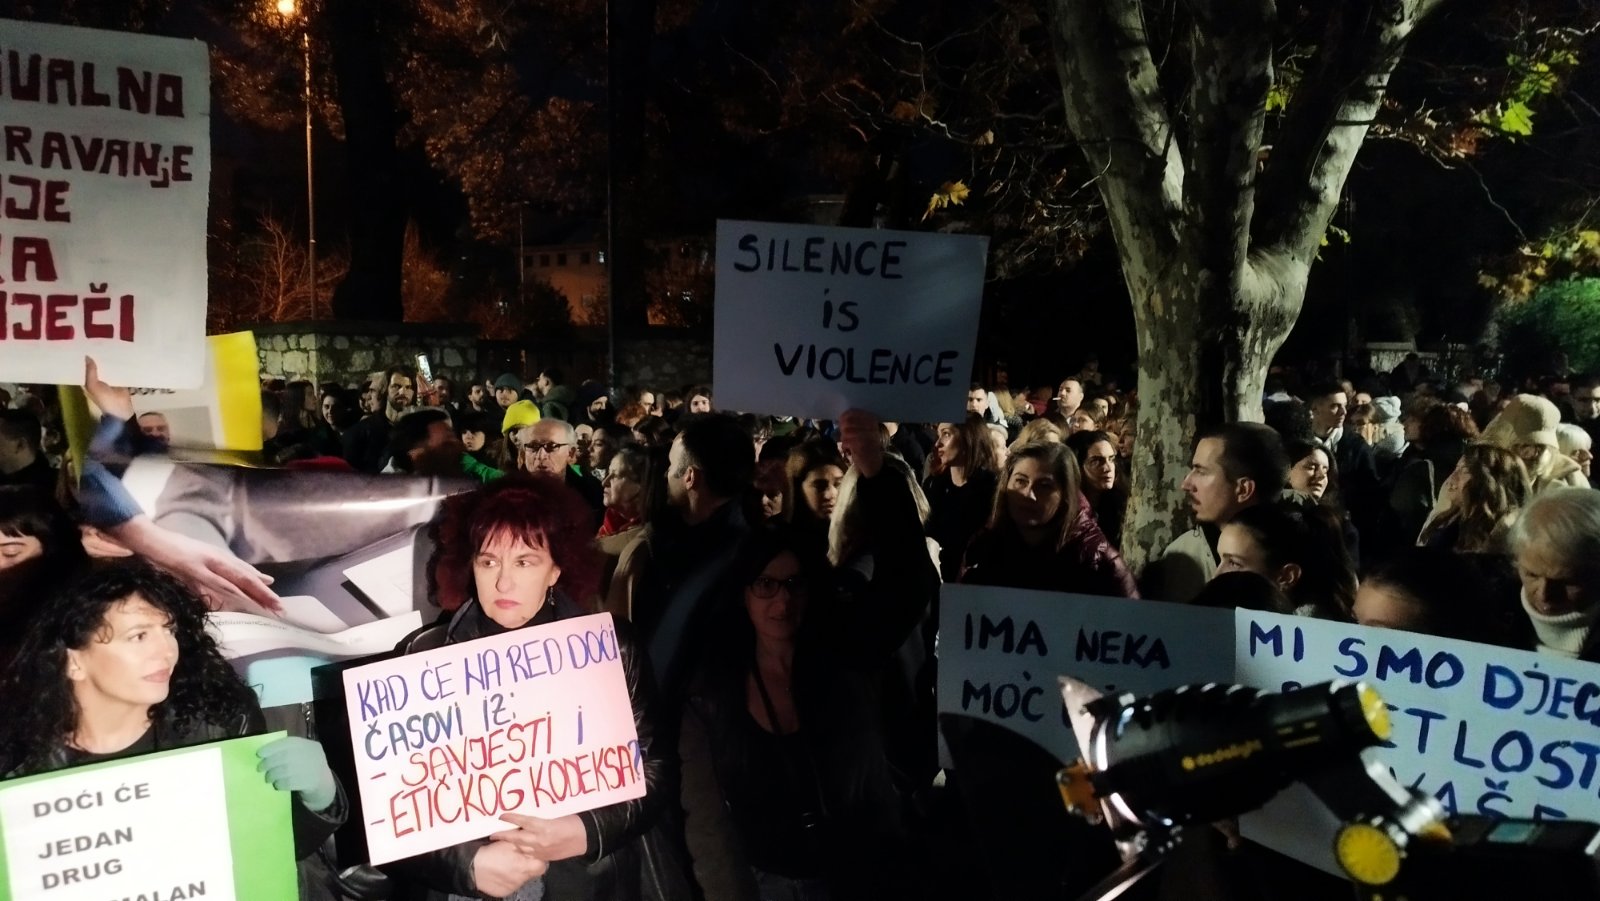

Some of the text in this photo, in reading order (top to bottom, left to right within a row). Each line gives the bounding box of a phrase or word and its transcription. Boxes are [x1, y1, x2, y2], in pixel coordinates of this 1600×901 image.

[0, 50, 184, 118] UALNO
[0, 175, 70, 223] JE
[0, 236, 57, 282] A
[734, 234, 906, 279] SILENCE
[774, 343, 959, 386] VIOLENCE
[965, 613, 1171, 670] IMA NEKA
[1250, 620, 1304, 662] MI
[1333, 637, 1464, 689] SMO
[356, 674, 409, 722] KAD
[420, 660, 456, 701] ĆE
[464, 648, 501, 696] NA
[506, 638, 563, 683] RED
[529, 739, 641, 808] KODEKSA?
[33, 782, 151, 818] DOĆI ĆE
[38, 826, 133, 860] JEDAN
[42, 858, 123, 890] DRUG
